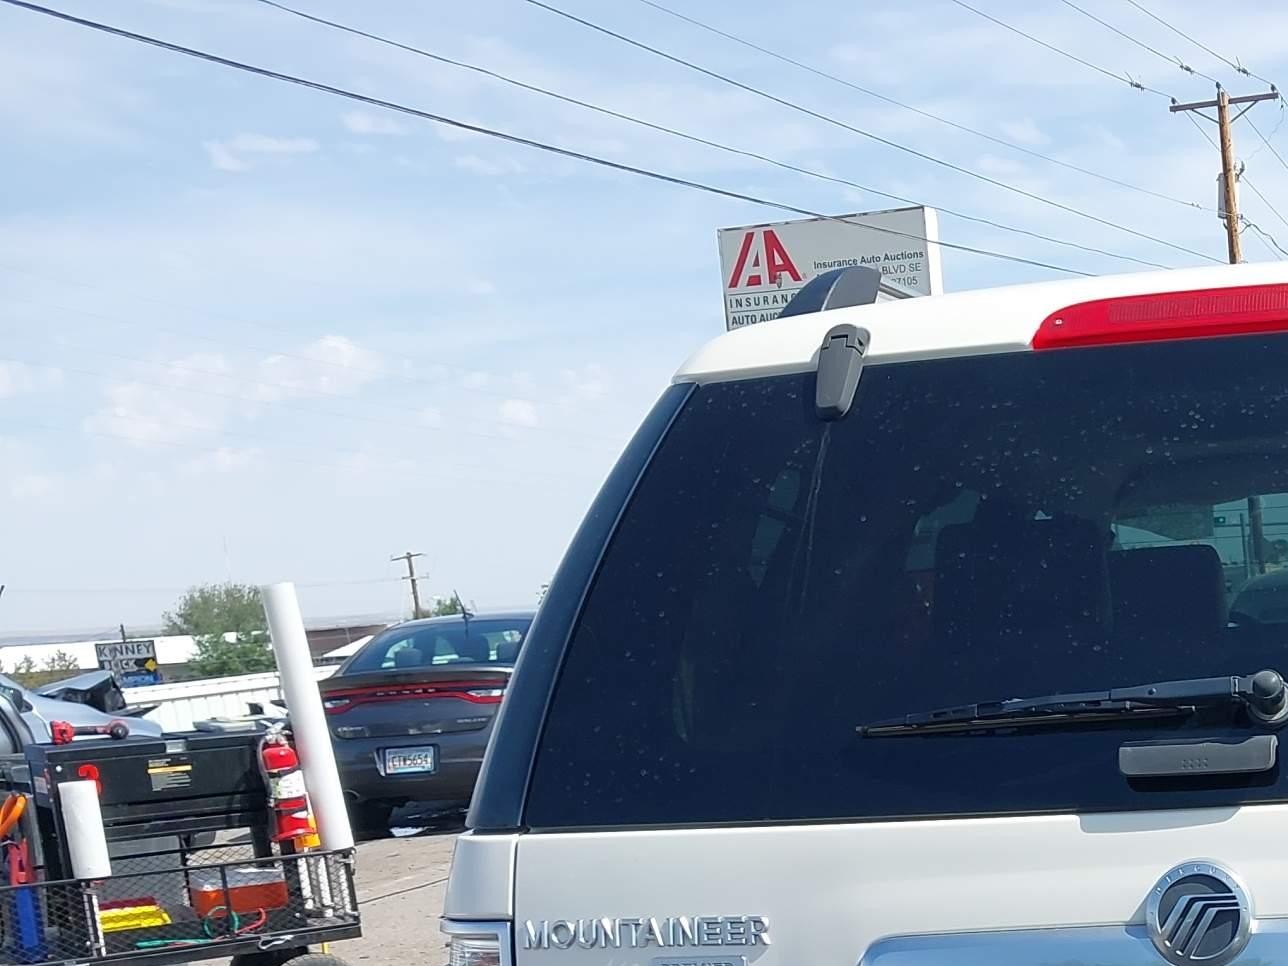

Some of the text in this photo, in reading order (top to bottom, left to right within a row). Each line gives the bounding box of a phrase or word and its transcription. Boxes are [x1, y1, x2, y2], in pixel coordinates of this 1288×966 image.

[813, 249, 924, 270] Insurance Auto Auctions
[881, 262, 922, 275] BLVD SE
[731, 310, 783, 326] AUTO AUC
[523, 915, 772, 950] MOUNTAINEER
